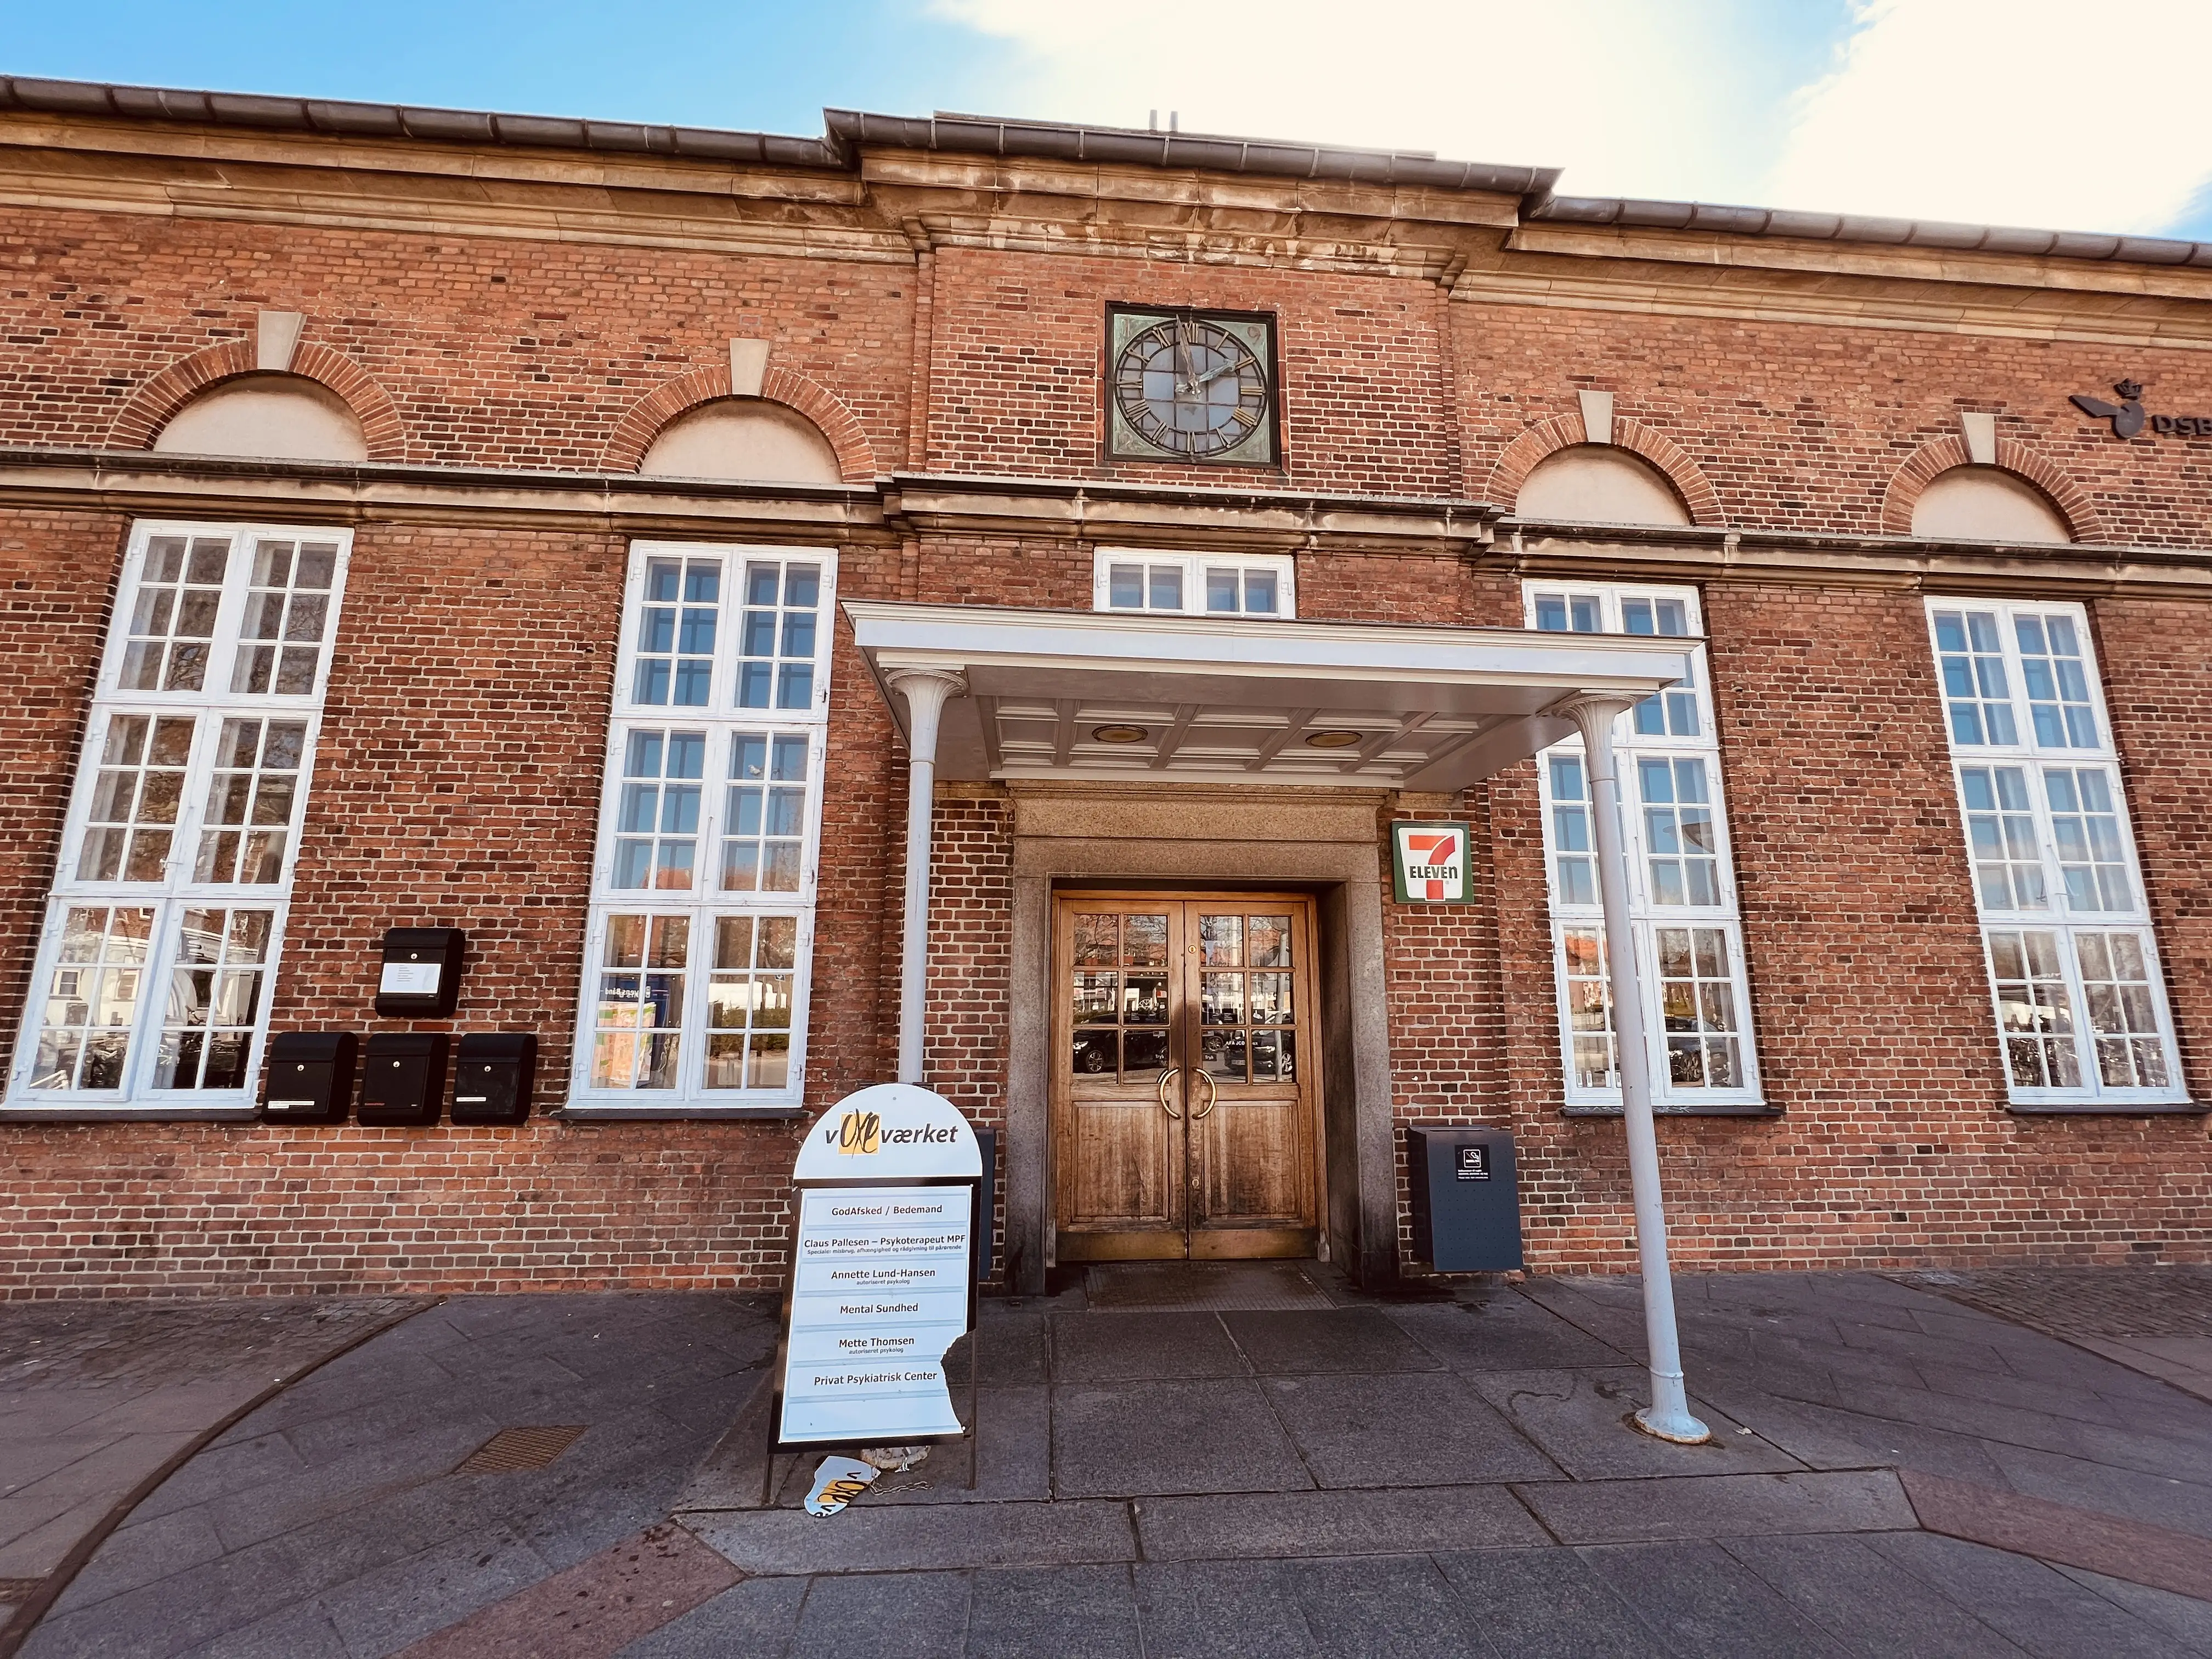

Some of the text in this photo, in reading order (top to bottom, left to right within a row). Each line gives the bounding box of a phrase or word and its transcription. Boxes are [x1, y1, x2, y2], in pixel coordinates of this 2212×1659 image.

[2152, 415, 2212, 436] DSB
[1408, 835, 1455, 900] 7
[832, 1205, 943, 1216] GodAfsked / Bedemand
[804, 1239, 829, 1248] Claus
[832, 1238, 869, 1247] Pallesen
[880, 1235, 945, 1246] Psykoterapeut
[947, 1234, 966, 1243] MPF
[831, 1268, 935, 1279] Annette Lund-Hansen
[840, 1303, 918, 1314] Mental Sundhed
[839, 1337, 915, 1348] Mette Thomsen
[814, 1372, 938, 1386] Privat Psykiatrisk Center
